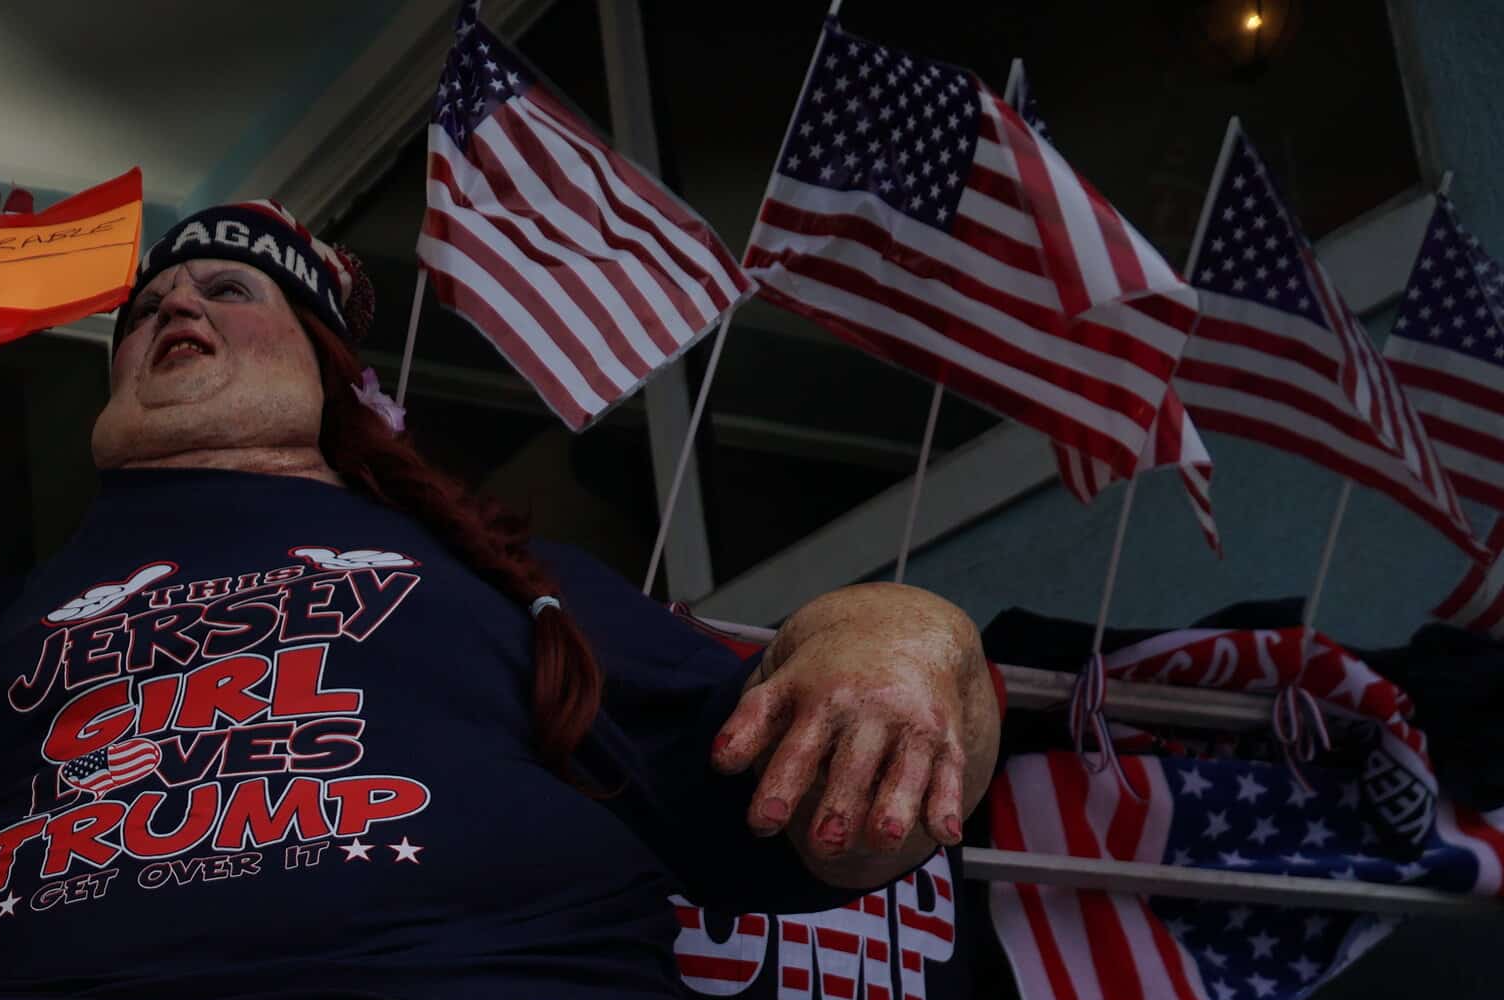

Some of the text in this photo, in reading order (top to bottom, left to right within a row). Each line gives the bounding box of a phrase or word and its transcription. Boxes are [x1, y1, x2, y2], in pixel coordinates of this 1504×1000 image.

[171, 219, 320, 295] AGAIN
[142, 565, 308, 607] THIS
[7, 568, 422, 713] JERSEY
[40, 641, 365, 765] GIRL
[29, 840, 332, 911] GET OVER IT
